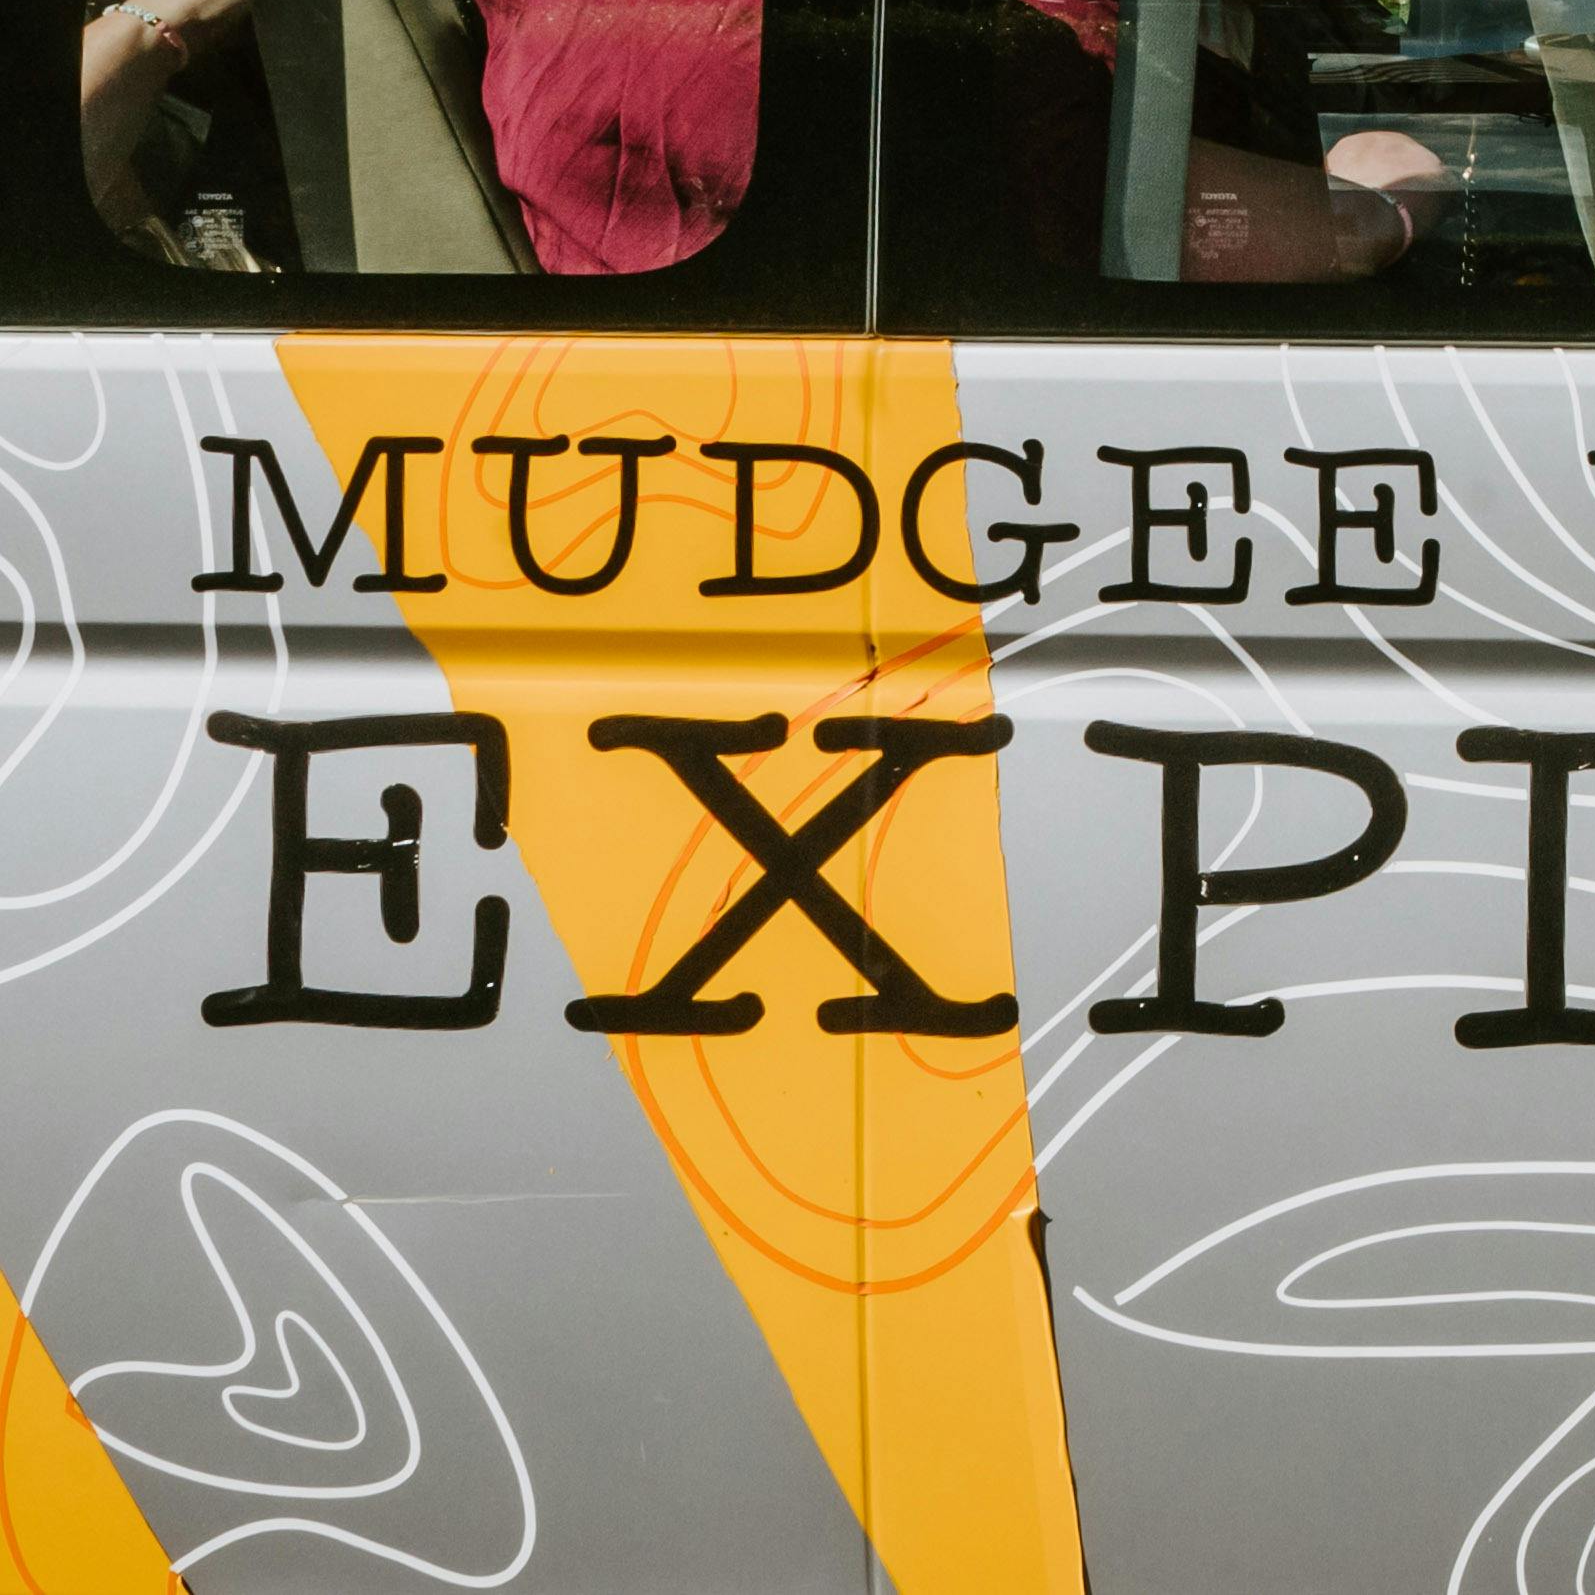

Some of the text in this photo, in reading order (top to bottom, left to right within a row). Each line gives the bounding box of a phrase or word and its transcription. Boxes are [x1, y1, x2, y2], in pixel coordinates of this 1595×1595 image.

[197, 193, 233, 201] TOYOTA
[1200, 192, 1237, 200] TOYOTA
[192, 435, 1439, 605] MUDGEE
